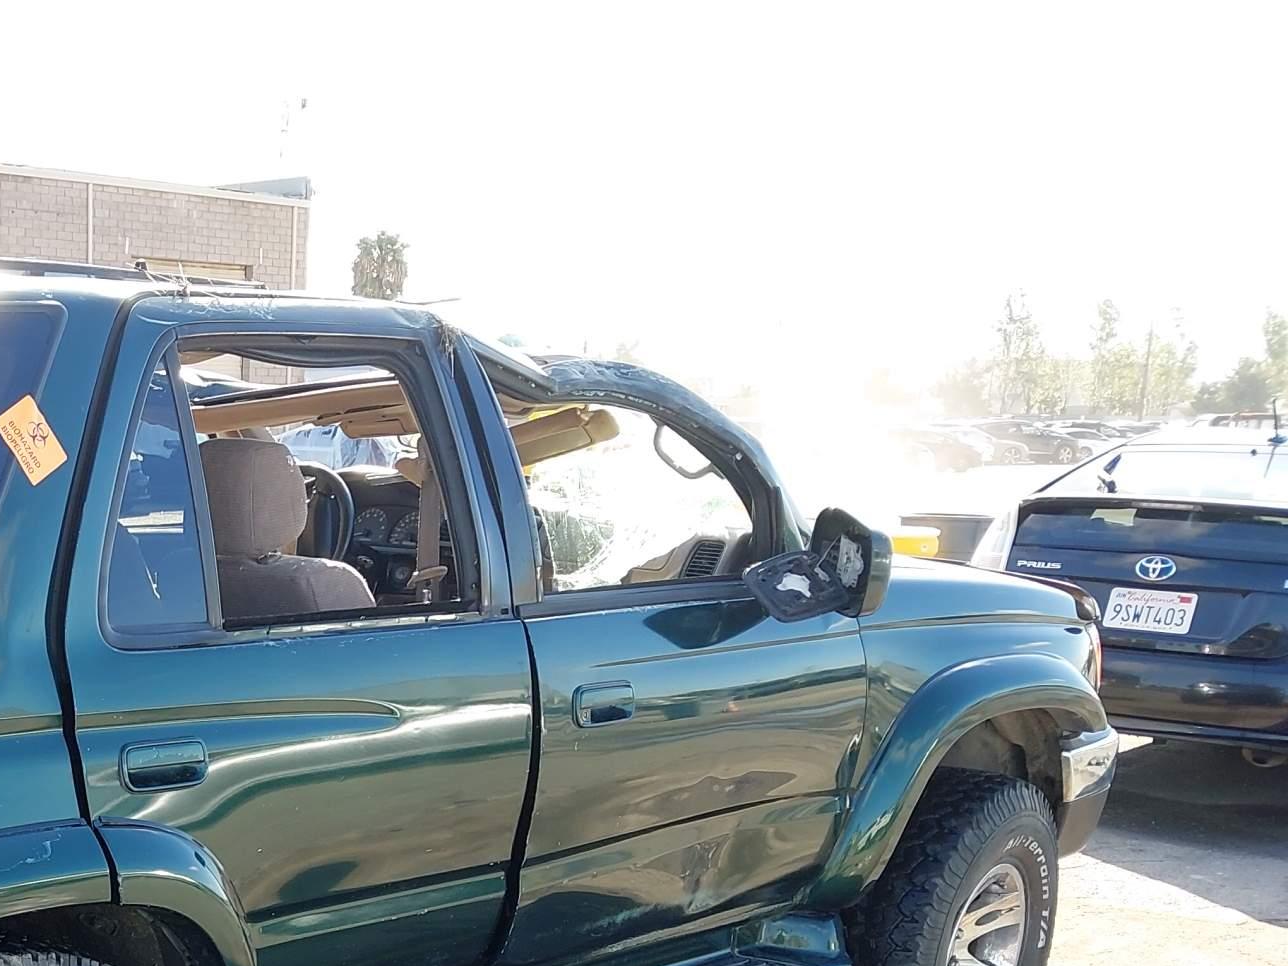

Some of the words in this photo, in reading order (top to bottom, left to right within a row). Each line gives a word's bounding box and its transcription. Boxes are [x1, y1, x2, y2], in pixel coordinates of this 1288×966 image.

[0, 425, 35, 474] BIOPELIGRO
[8, 420, 41, 469] BIOHAZARD
[1017, 560, 1062, 569] PRIUS
[1109, 603, 1187, 627] 9SWT403
[1127, 590, 1178, 605] California
[1003, 834, 1050, 900] All-Terrain
[1037, 906, 1050, 949] T/A
